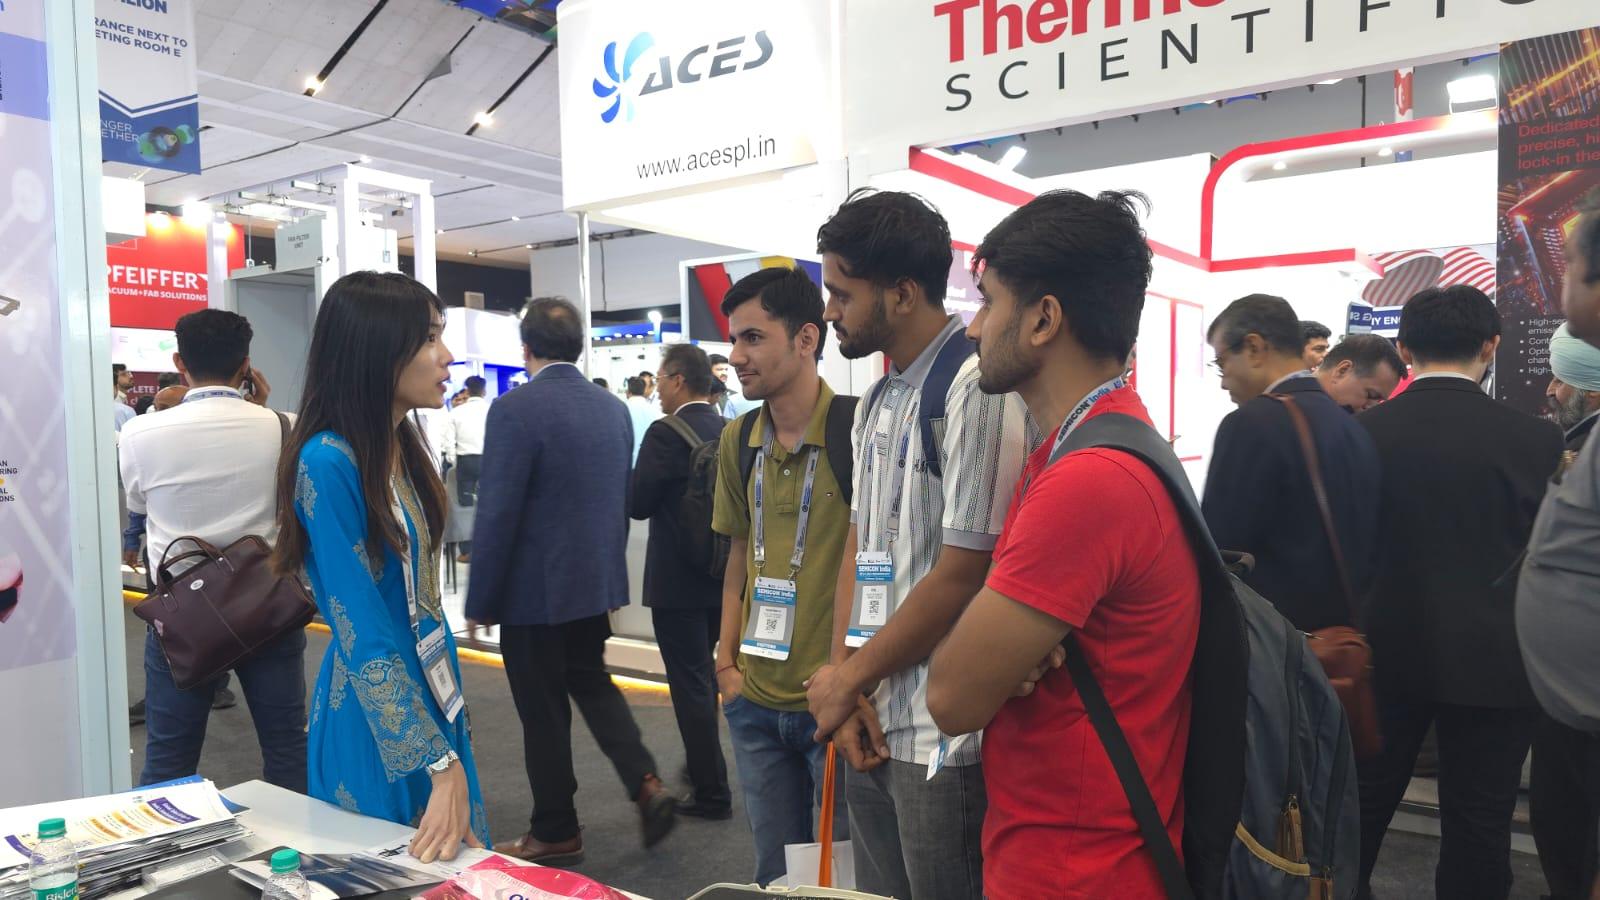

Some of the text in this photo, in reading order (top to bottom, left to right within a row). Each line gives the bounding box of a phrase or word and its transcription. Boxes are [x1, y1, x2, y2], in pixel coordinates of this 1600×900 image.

[137, 28, 169, 43] NEXT
[171, 36, 188, 48] TO
[934, 0, 1226, 63] Ther
[134, 38, 170, 55] ROOM
[173, 48, 182, 58] E
[945, 0, 1536, 112] SCIENTIF
[638, 30, 774, 96] ACES
[1518, 114, 1600, 137] Dedicated
[637, 134, 776, 179] www.acespl.in
[1518, 137, 1580, 156] precise,
[1518, 154, 1570, 170] lock-in
